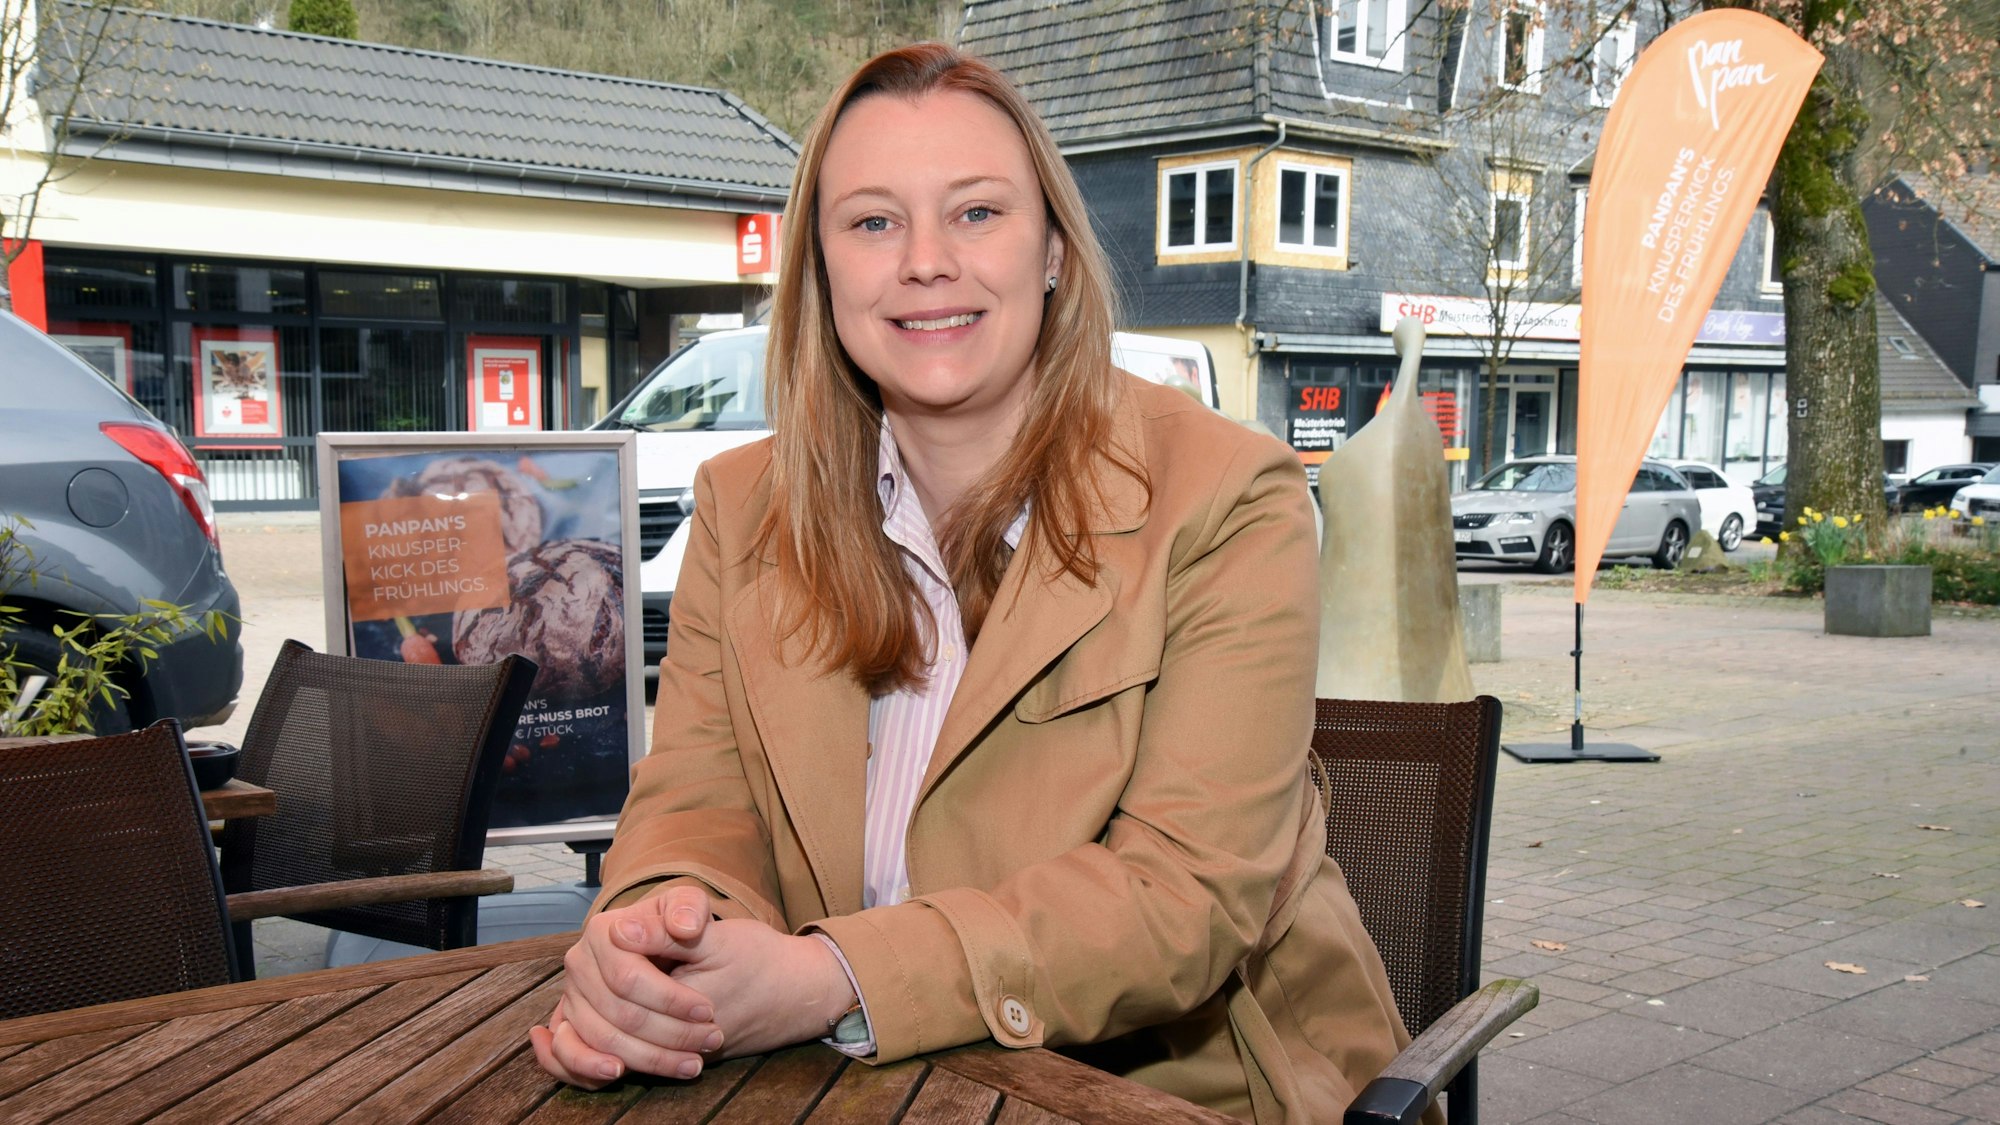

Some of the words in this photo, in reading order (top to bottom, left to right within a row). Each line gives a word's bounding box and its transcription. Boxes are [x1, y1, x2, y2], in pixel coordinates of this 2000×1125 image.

[1710, 62, 1779, 131] pan
[1641, 146, 1695, 249] PANPAN'S
[1647, 155, 1716, 293] KNUSPERKICK
[1658, 282, 1686, 322] DES
[1676, 167, 1736, 280] FRÜHLINGS.
[1299, 386, 1341, 411] SHB
[368, 537, 468, 559] KNUSPER-
[371, 562, 416, 581] KICK
[421, 558, 460, 576] DES
[374, 577, 489, 602] FRÜHLINGS.
[518, 710, 573, 725] RE-NUSS
[575, 705, 610, 719] BROT
[534, 723, 574, 738] STÜCK
